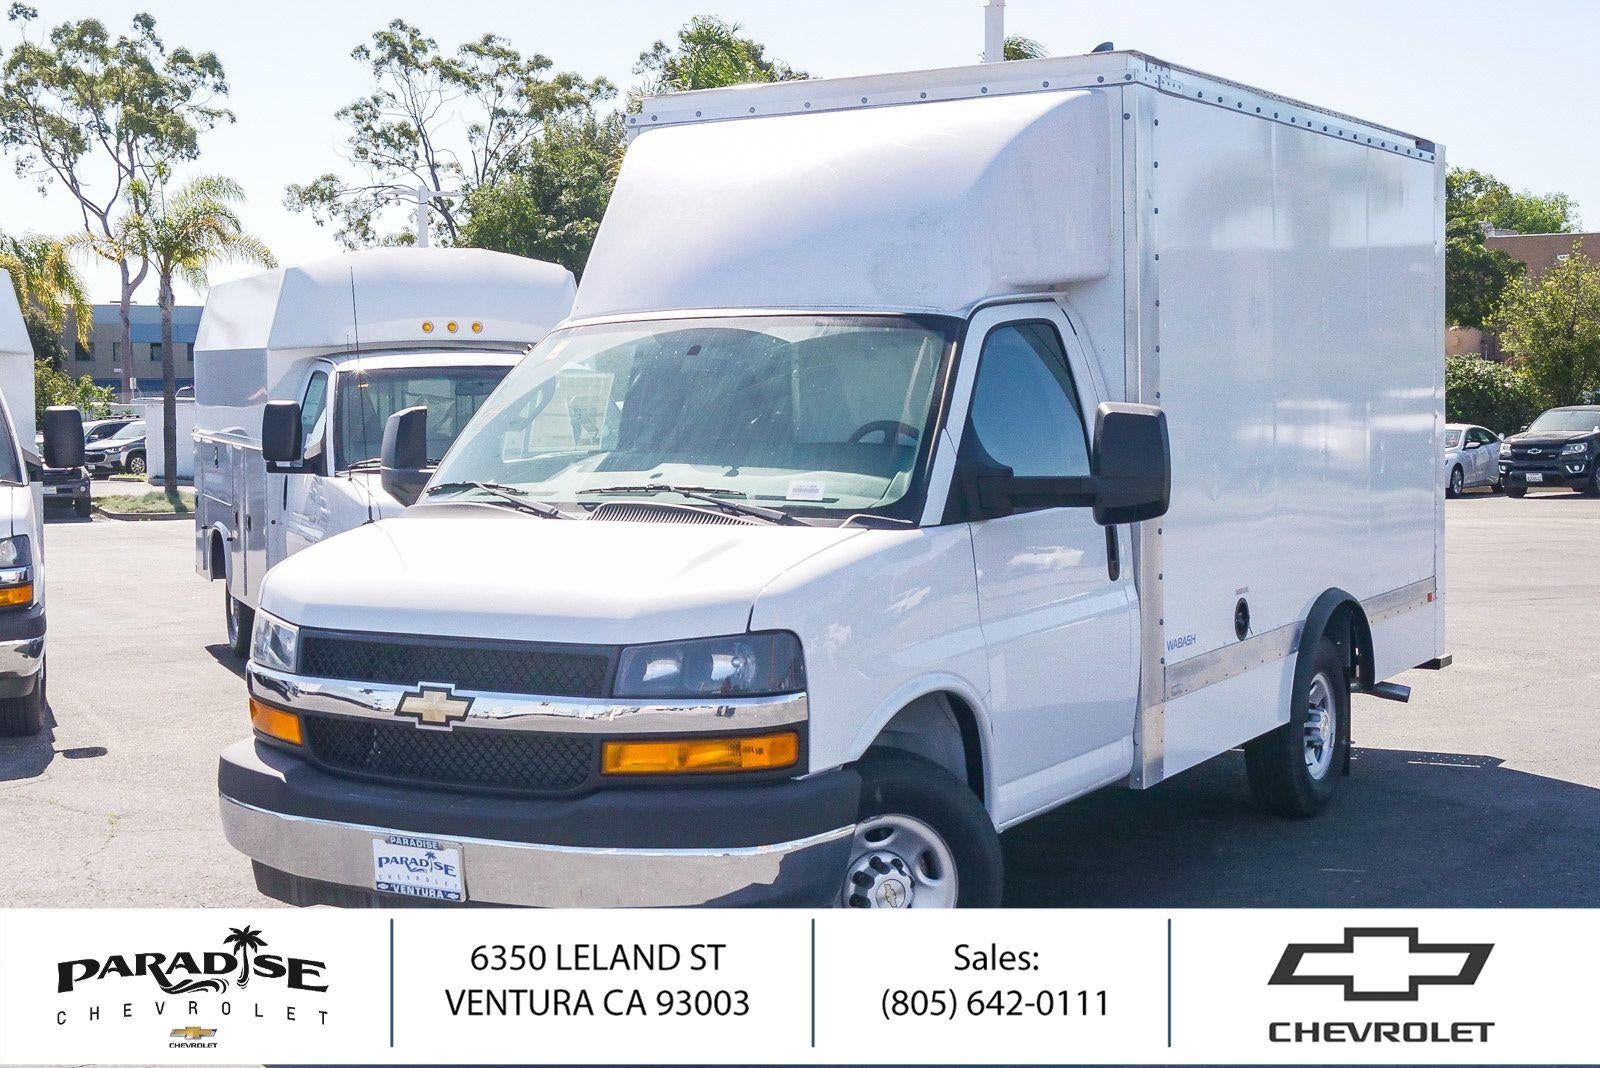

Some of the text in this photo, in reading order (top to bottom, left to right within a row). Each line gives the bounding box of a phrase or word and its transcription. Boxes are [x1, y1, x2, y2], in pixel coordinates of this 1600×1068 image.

[1167, 633, 1197, 651] WABASH
[390, 836, 439, 850] PARADISE
[377, 851, 457, 878] PARADISE
[391, 885, 444, 899] VENTURA
